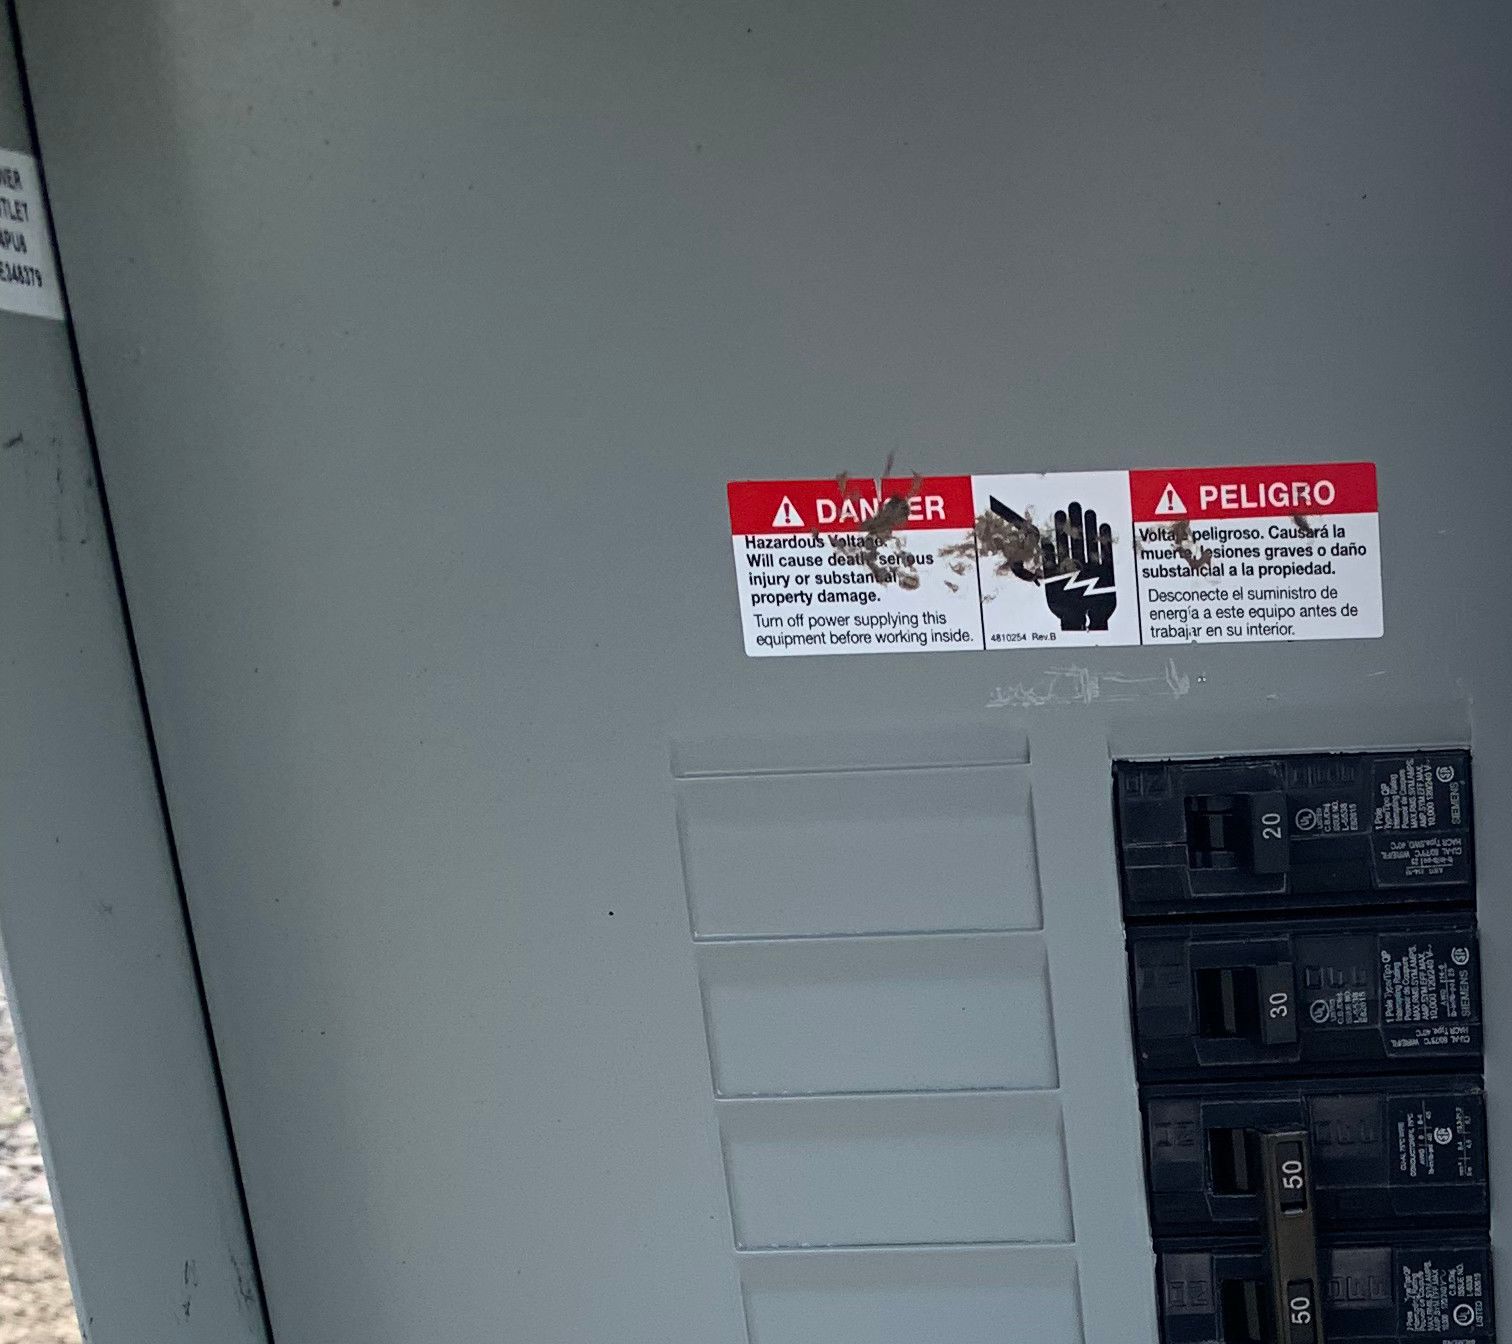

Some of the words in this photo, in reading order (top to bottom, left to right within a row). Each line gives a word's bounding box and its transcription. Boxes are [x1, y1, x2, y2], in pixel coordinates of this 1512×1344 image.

[1199, 480, 1336, 510] PELIGRO
[816, 496, 946, 524] DANER
[745, 535, 824, 549] Hazardous
[829, 534, 888, 548] Voltae.
[1192, 527, 1264, 543] peligroso.
[1268, 525, 1329, 539] Causará
[1333, 525, 1345, 538] la
[1265, 545, 1313, 559] graves
[1317, 546, 1326, 556] o
[1331, 542, 1367, 556] daño
[747, 553, 774, 567] Will
[778, 554, 826, 567] cause
[1142, 563, 1225, 578] substancial
[1229, 566, 1238, 577] a
[1241, 563, 1254, 576] la
[1258, 561, 1336, 578] propiedad.
[748, 571, 789, 587] injury
[795, 574, 810, 585] or
[751, 590, 813, 607] property
[817, 589, 881, 604] damage.
[1148, 588, 1228, 602] Desconecte
[1232, 588, 1244, 600] el
[1247, 586, 1316, 600] suministro
[1320, 587, 1338, 599] de
[753, 614, 782, 628] Turn
[786, 613, 804, 627] off
[808, 614, 851, 630] power
[854, 612, 918, 628] supplying
[922, 612, 947, 625] this
[1203, 609, 1212, 619] a
[1216, 606, 1244, 619] este
[1248, 605, 1295, 621] equipo
[1300, 604, 1337, 617] antes
[1341, 603, 1358, 617] de
[756, 632, 826, 649] equipment
[830, 630, 872, 645] before
[875, 628, 927, 644] working
[930, 628, 974, 643] inside.
[1150, 623, 1200, 639] trabajar
[1206, 626, 1223, 637] en
[1226, 625, 1243, 637] su
[1246, 622, 1295, 637] interior.
[1450, 782, 1460, 824] SIEMENS
[1262, 813, 1282, 839] 20
[1427, 959, 1436, 990] 120/240
[1459, 970, 1471, 1017] SIEMENS
[1270, 992, 1288, 1018] 30
[1386, 999, 1394, 1016] Pole
[1283, 1160, 1302, 1189] 50
[1292, 1297, 1310, 1325] 50
[1475, 1301, 1483, 1327] LISTED
